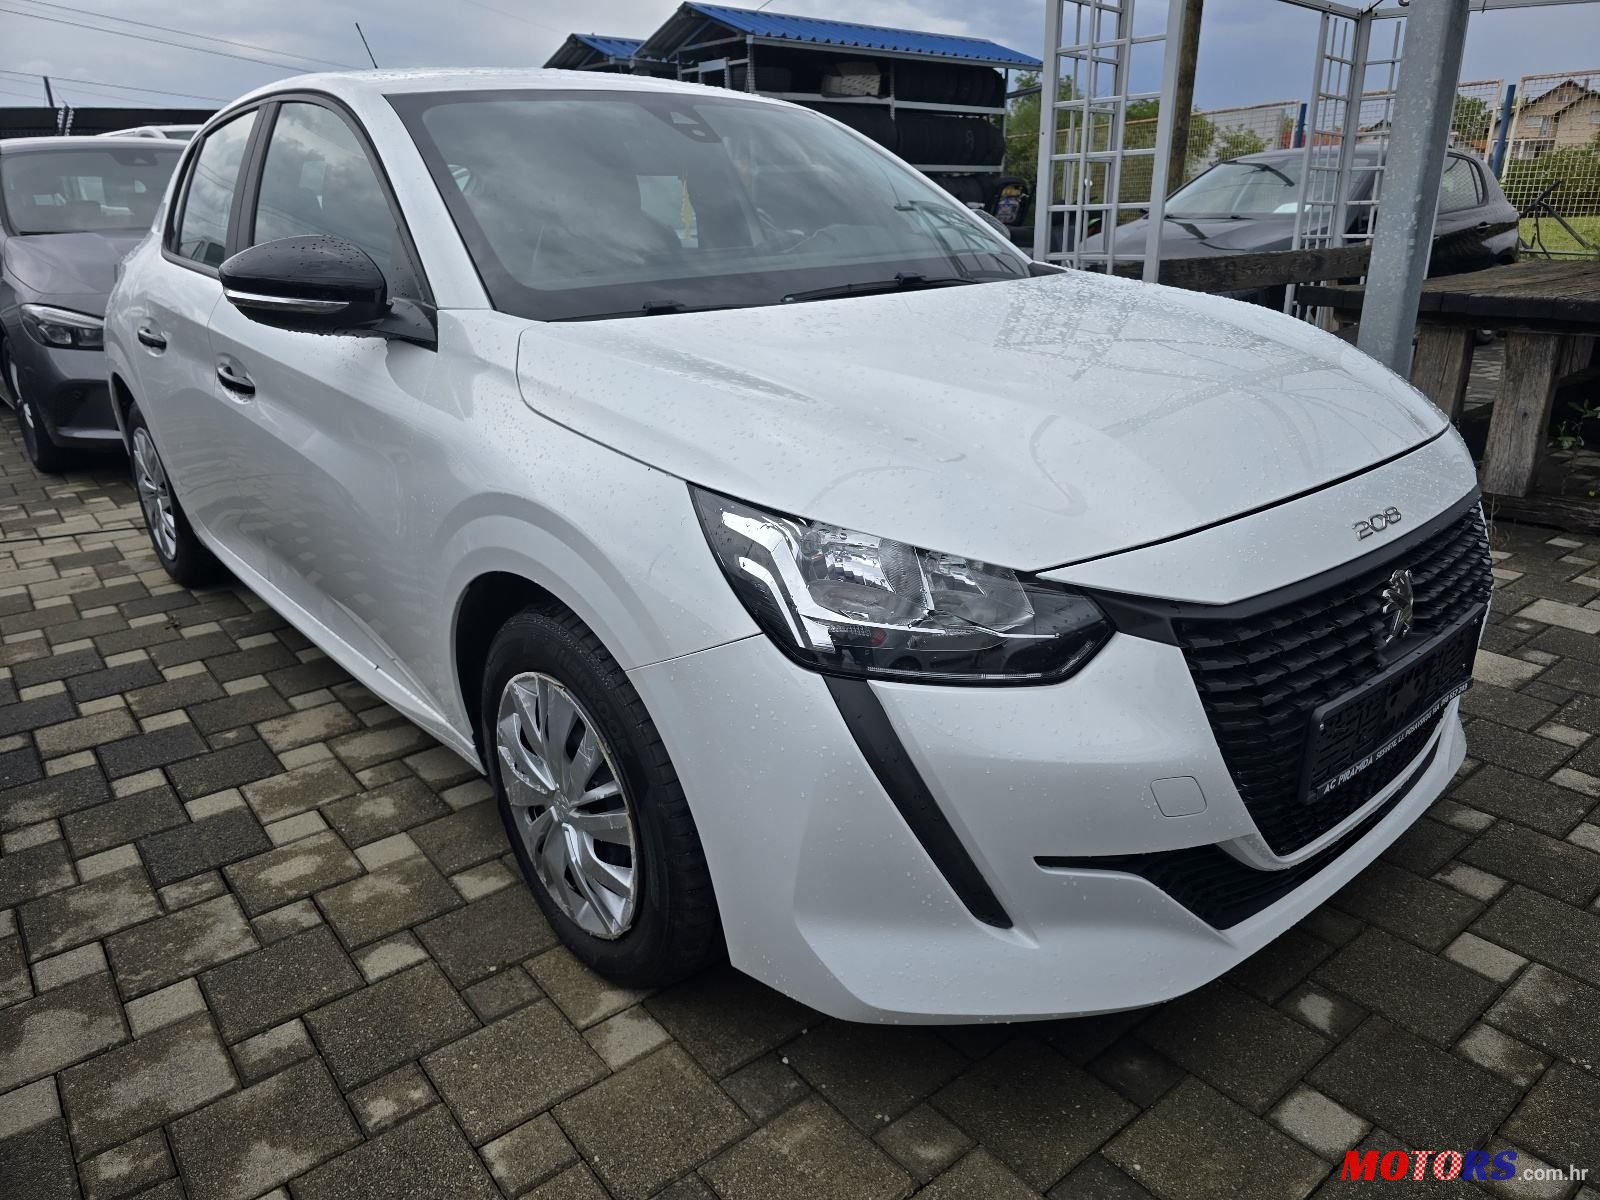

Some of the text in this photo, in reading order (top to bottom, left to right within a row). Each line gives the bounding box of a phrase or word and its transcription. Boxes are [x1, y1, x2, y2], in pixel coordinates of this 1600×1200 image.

[1352, 506, 1401, 541] 208
[1323, 778, 1337, 795] AC
[1337, 755, 1373, 785] PIRAMIDA
